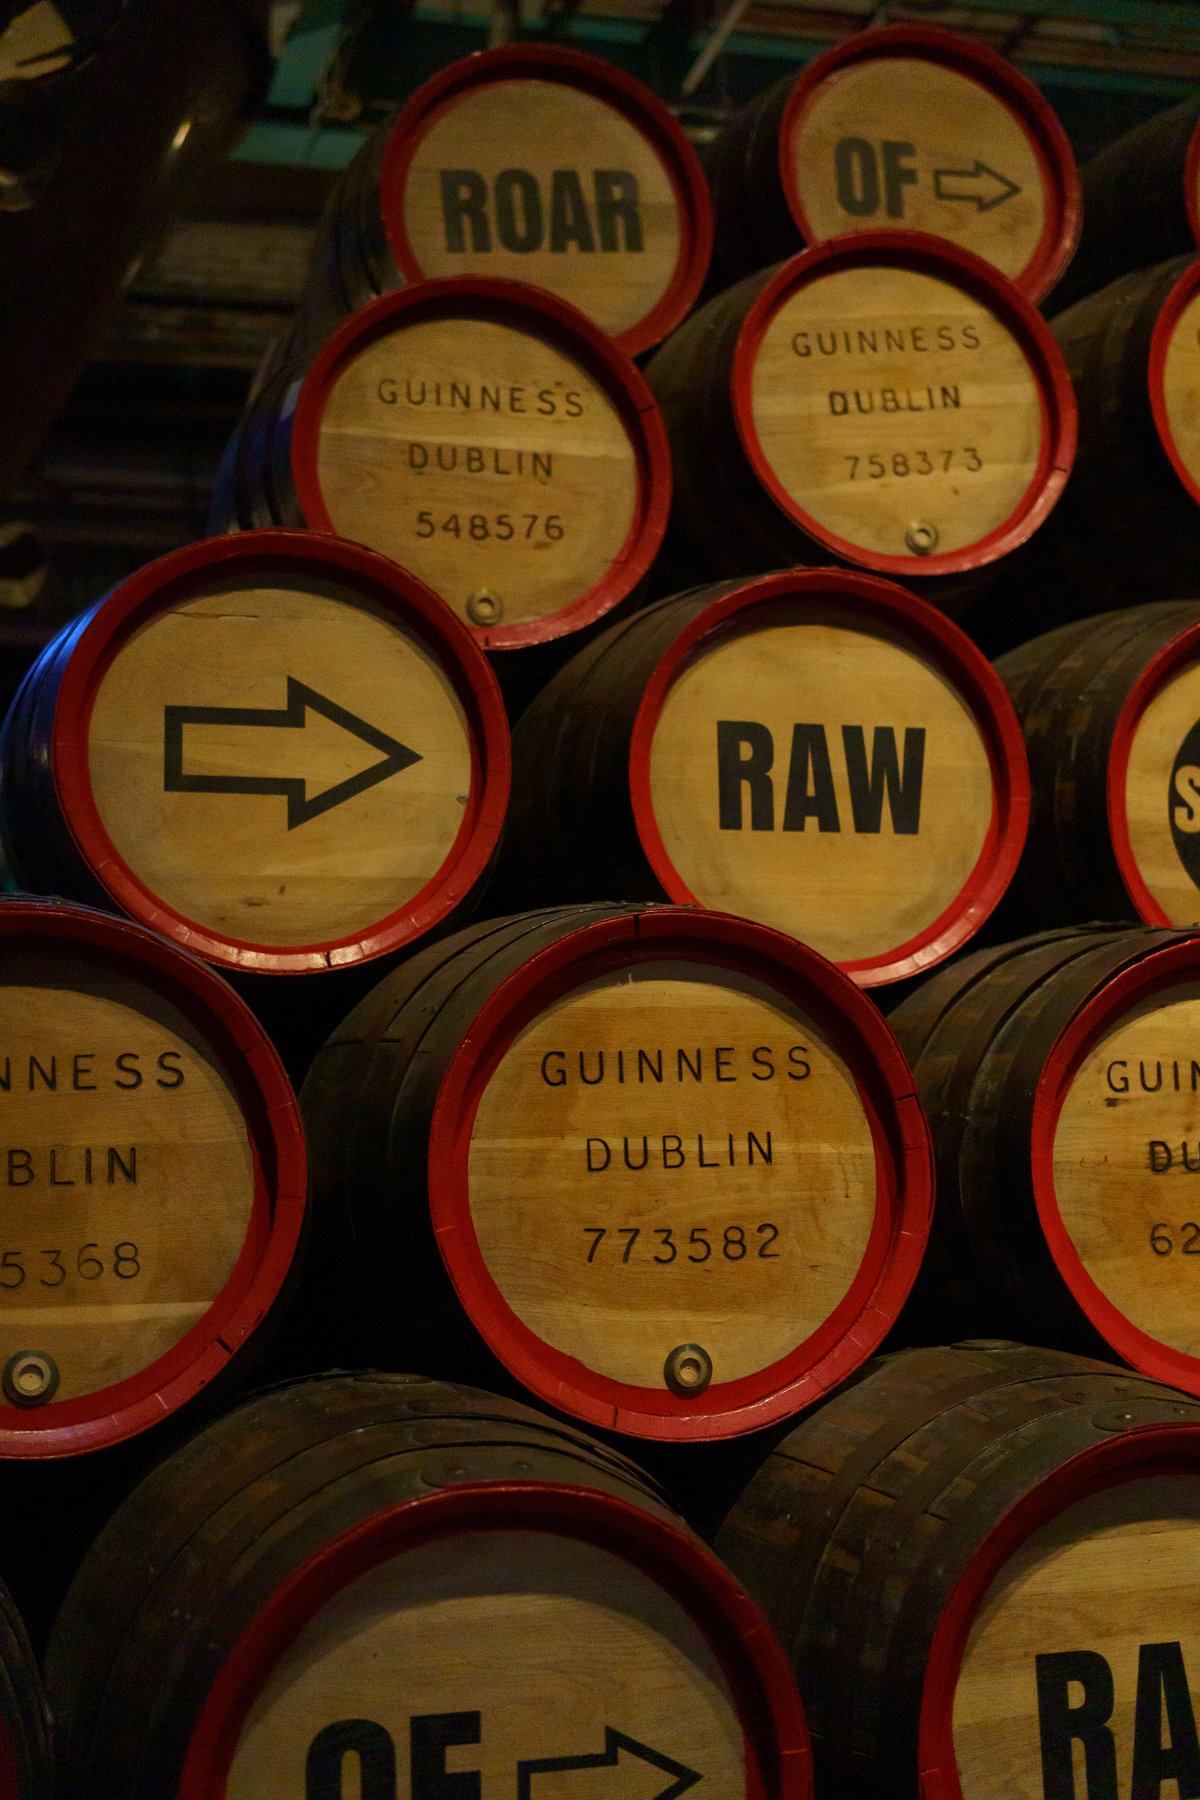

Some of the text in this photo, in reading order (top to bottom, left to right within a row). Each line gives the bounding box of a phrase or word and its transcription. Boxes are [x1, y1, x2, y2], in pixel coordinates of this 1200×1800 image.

[834, 136, 918, 219] OF
[440, 169, 644, 254] ROAR
[792, 325, 981, 358] GUINNESS
[378, 379, 584, 417] GUINNESS
[828, 384, 961, 416] DUBLIN
[408, 444, 553, 477] DUBLIN
[844, 447, 982, 480] 758373
[416, 511, 564, 541] 548576
[717, 720, 926, 835] RAW
[541, 1046, 812, 1087] GUINNESS
[8, 1146, 138, 1186] BLIN
[586, 1131, 773, 1173] DUBLIN
[583, 1223, 780, 1264] 773582
[0, 1242, 141, 1289] 5368
[1035, 1641, 1200, 1800] RA
